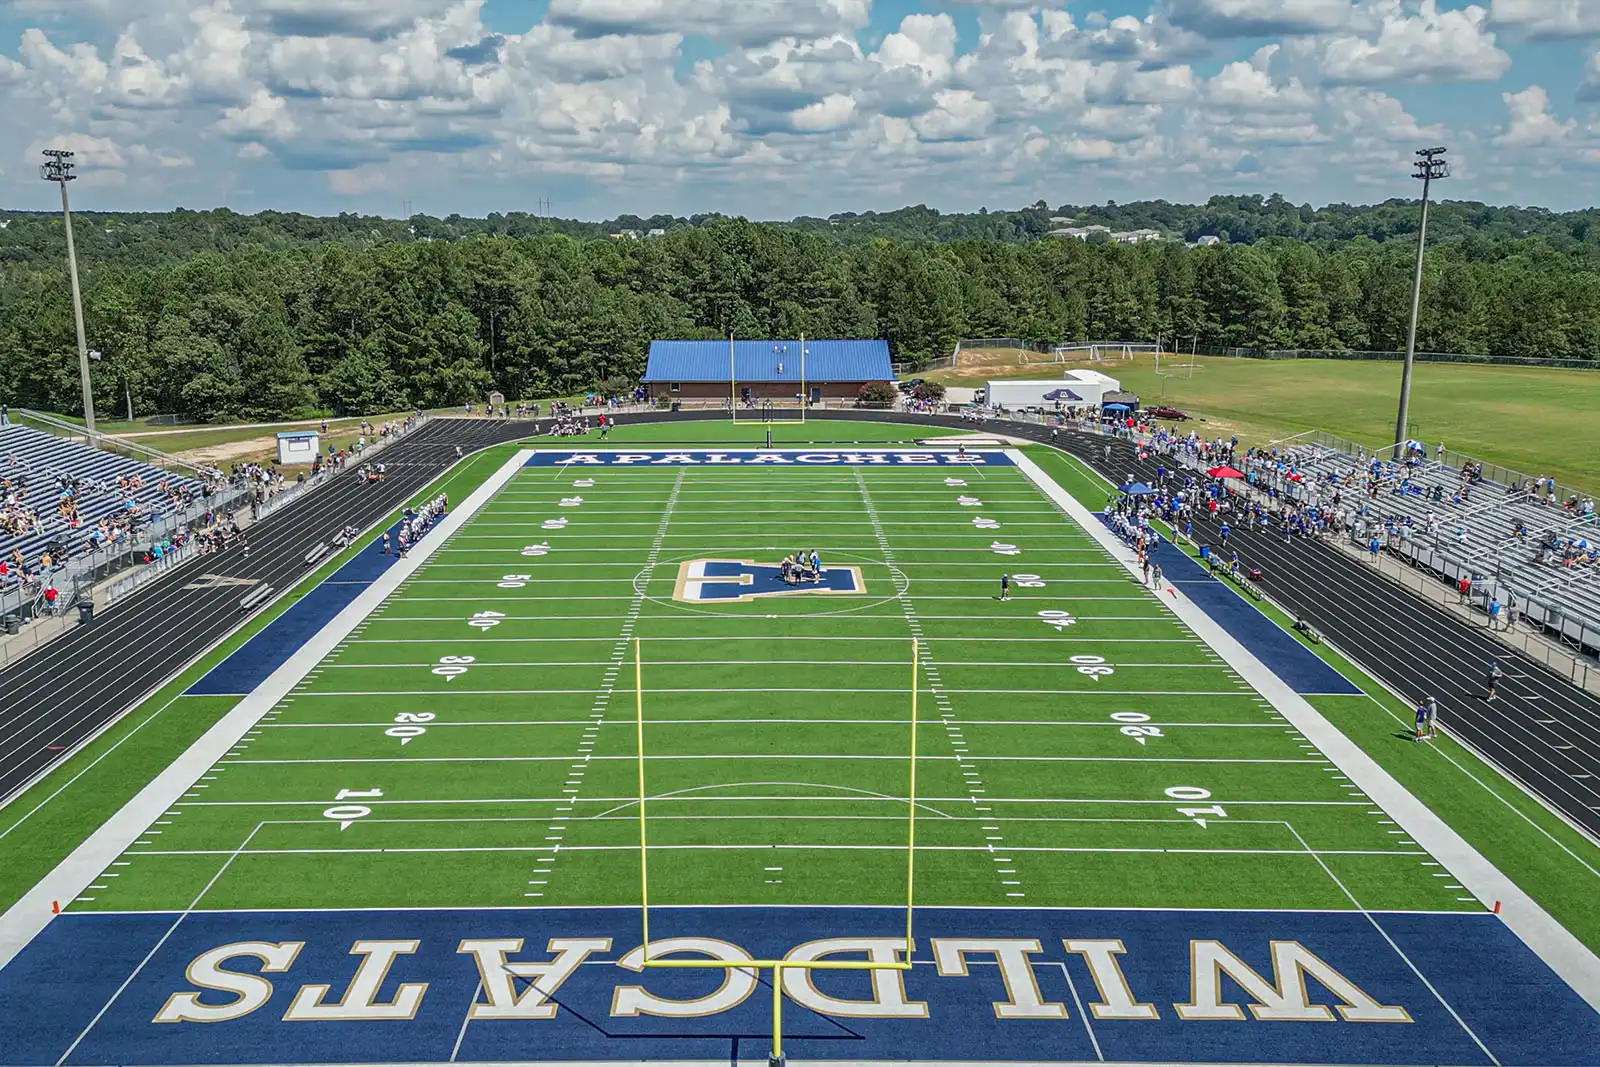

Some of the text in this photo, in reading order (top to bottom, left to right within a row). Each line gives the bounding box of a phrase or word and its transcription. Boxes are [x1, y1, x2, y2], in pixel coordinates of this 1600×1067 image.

[554, 453, 986, 465] APALACHEE
[496, 574, 532, 588] 50
[1011, 573, 1047, 588] 50
[466, 609, 506, 627] 40
[1037, 609, 1077, 627] 40
[431, 655, 476, 676] 30
[1069, 654, 1115, 676] 30
[384, 712, 437, 737] 20
[1109, 711, 1165, 737] 20
[322, 787, 385, 819] 10
[1164, 786, 1228, 818] 10
[151, 936, 1415, 1025] WILDCATS
